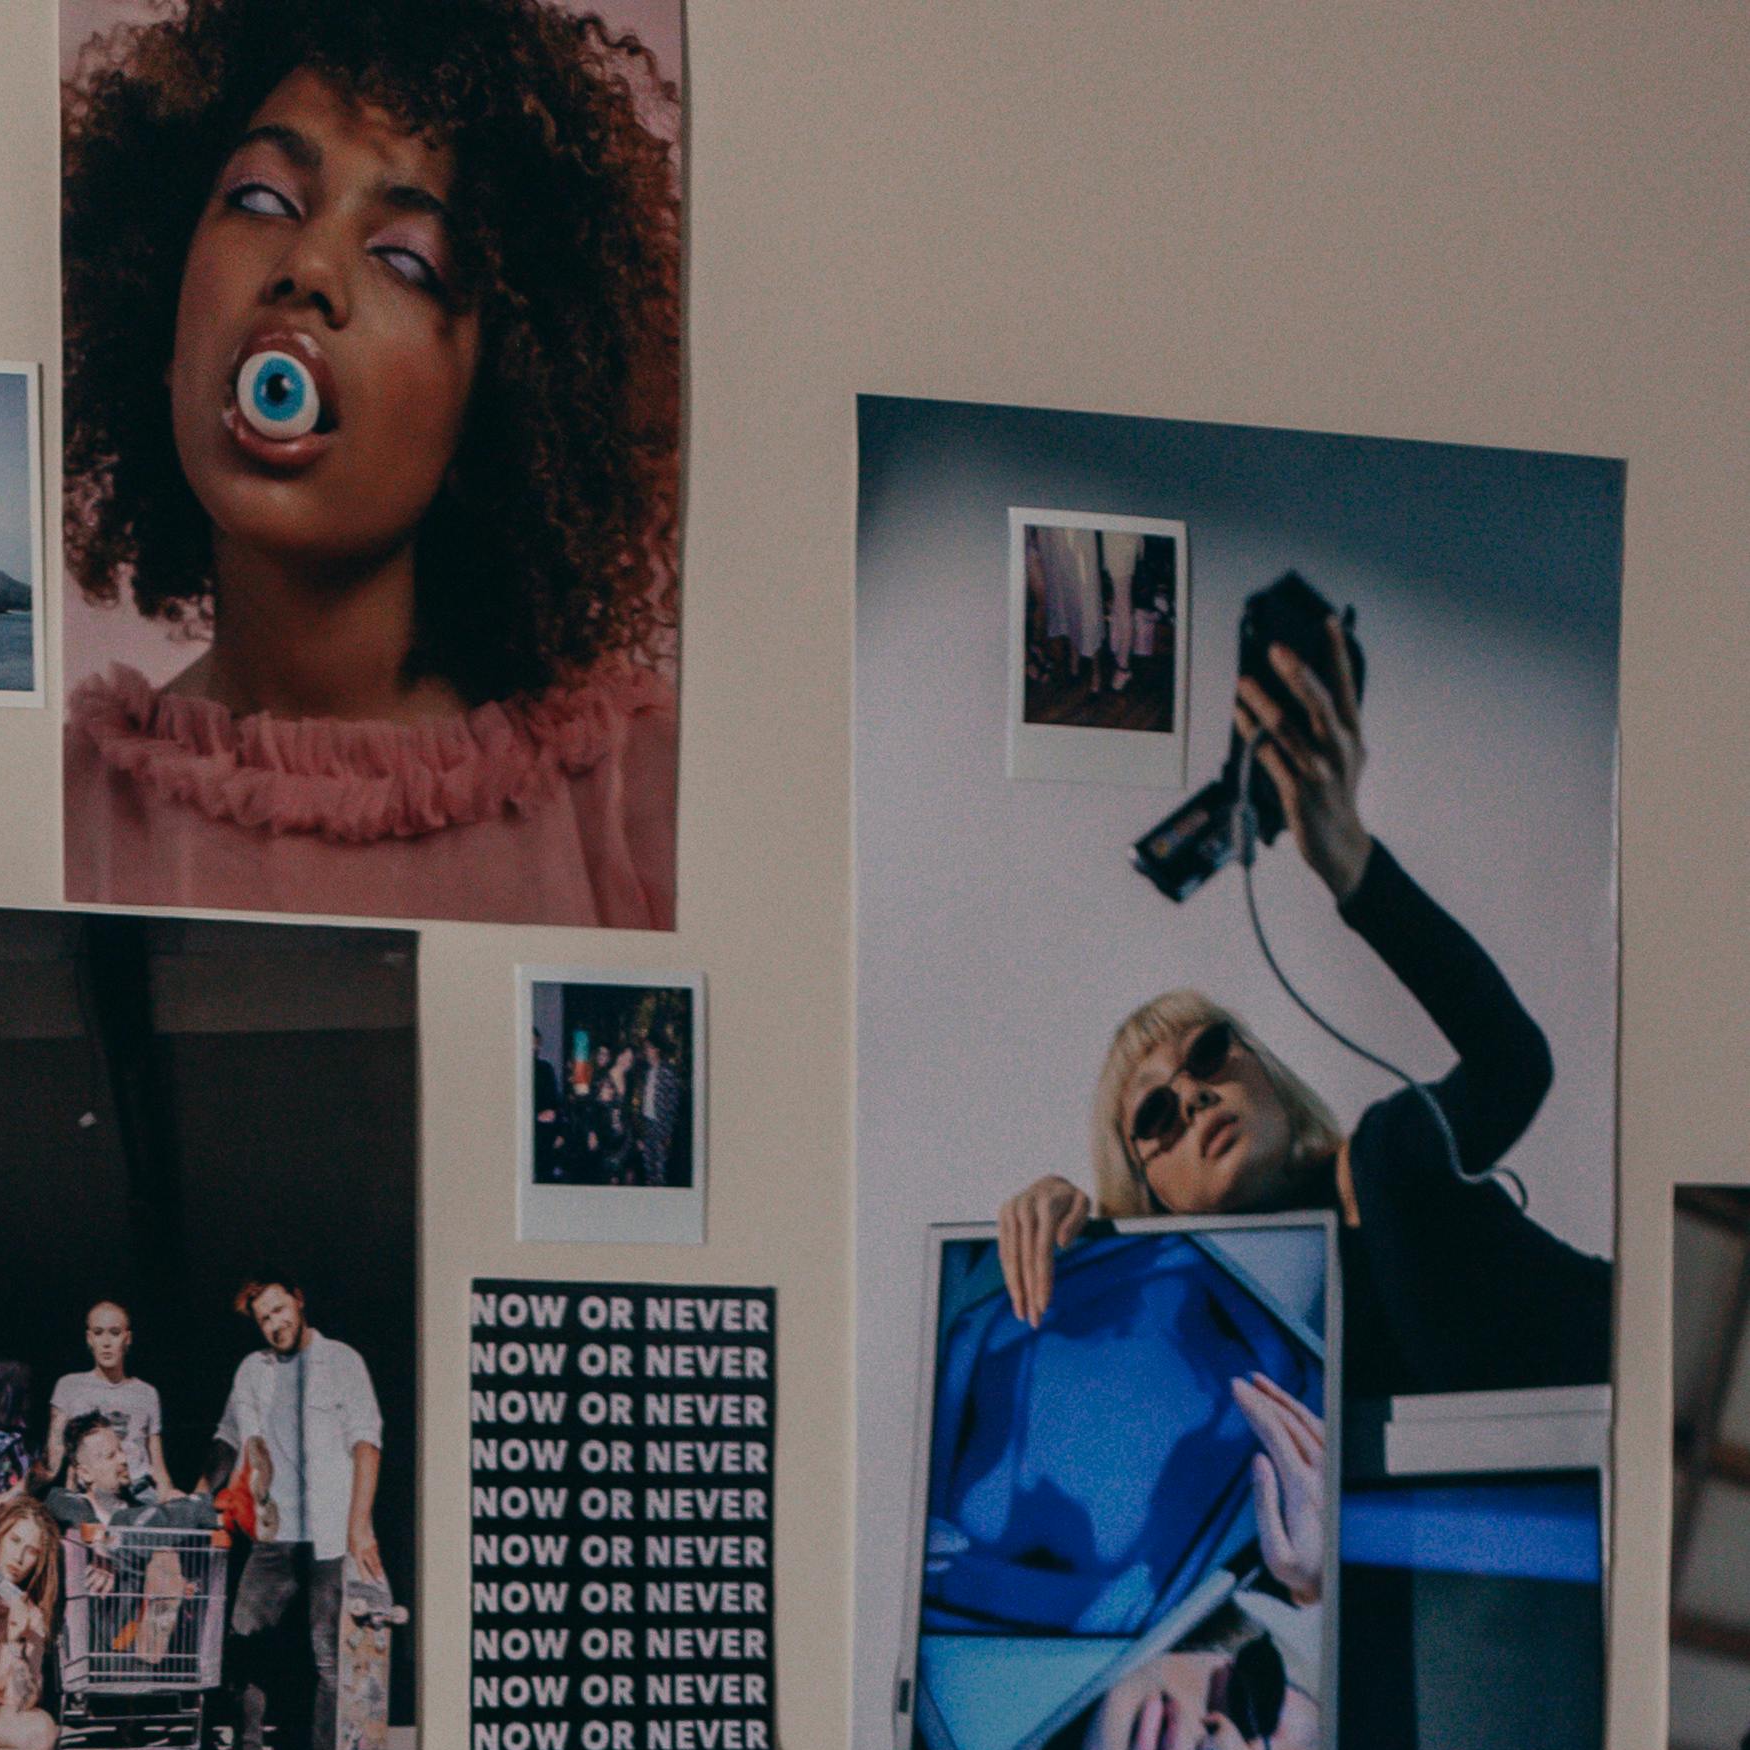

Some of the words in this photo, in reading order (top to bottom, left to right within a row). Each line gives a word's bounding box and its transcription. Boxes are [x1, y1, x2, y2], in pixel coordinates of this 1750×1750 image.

[472, 1292, 567, 1327] NOW
[579, 1296, 633, 1329] OR
[646, 1298, 767, 1331] NEVER
[472, 1342, 566, 1375] NOW
[579, 1344, 632, 1376] OR
[646, 1346, 767, 1378] NEVER
[472, 1391, 566, 1423] NOW
[579, 1392, 632, 1424] OR
[646, 1394, 766, 1426] NEVER
[472, 1439, 567, 1471] NOW
[580, 1440, 633, 1472] OR
[647, 1442, 766, 1472] NEVER
[472, 1487, 567, 1518] NOW
[581, 1488, 633, 1519] OR
[646, 1489, 765, 1519] NEVER
[473, 1535, 568, 1565] NOW
[581, 1536, 632, 1566] OR
[647, 1536, 765, 1566] NEVER
[473, 1582, 568, 1613] NOW
[581, 1583, 633, 1613] OR
[647, 1583, 765, 1612] NEVER
[474, 1629, 568, 1660] NOW
[581, 1629, 632, 1659] OR
[647, 1629, 765, 1658] NEVER
[474, 1676, 568, 1707] NOW
[582, 1675, 633, 1705] OR
[648, 1675, 765, 1704] NEVER
[648, 1720, 767, 1750] NEVER
